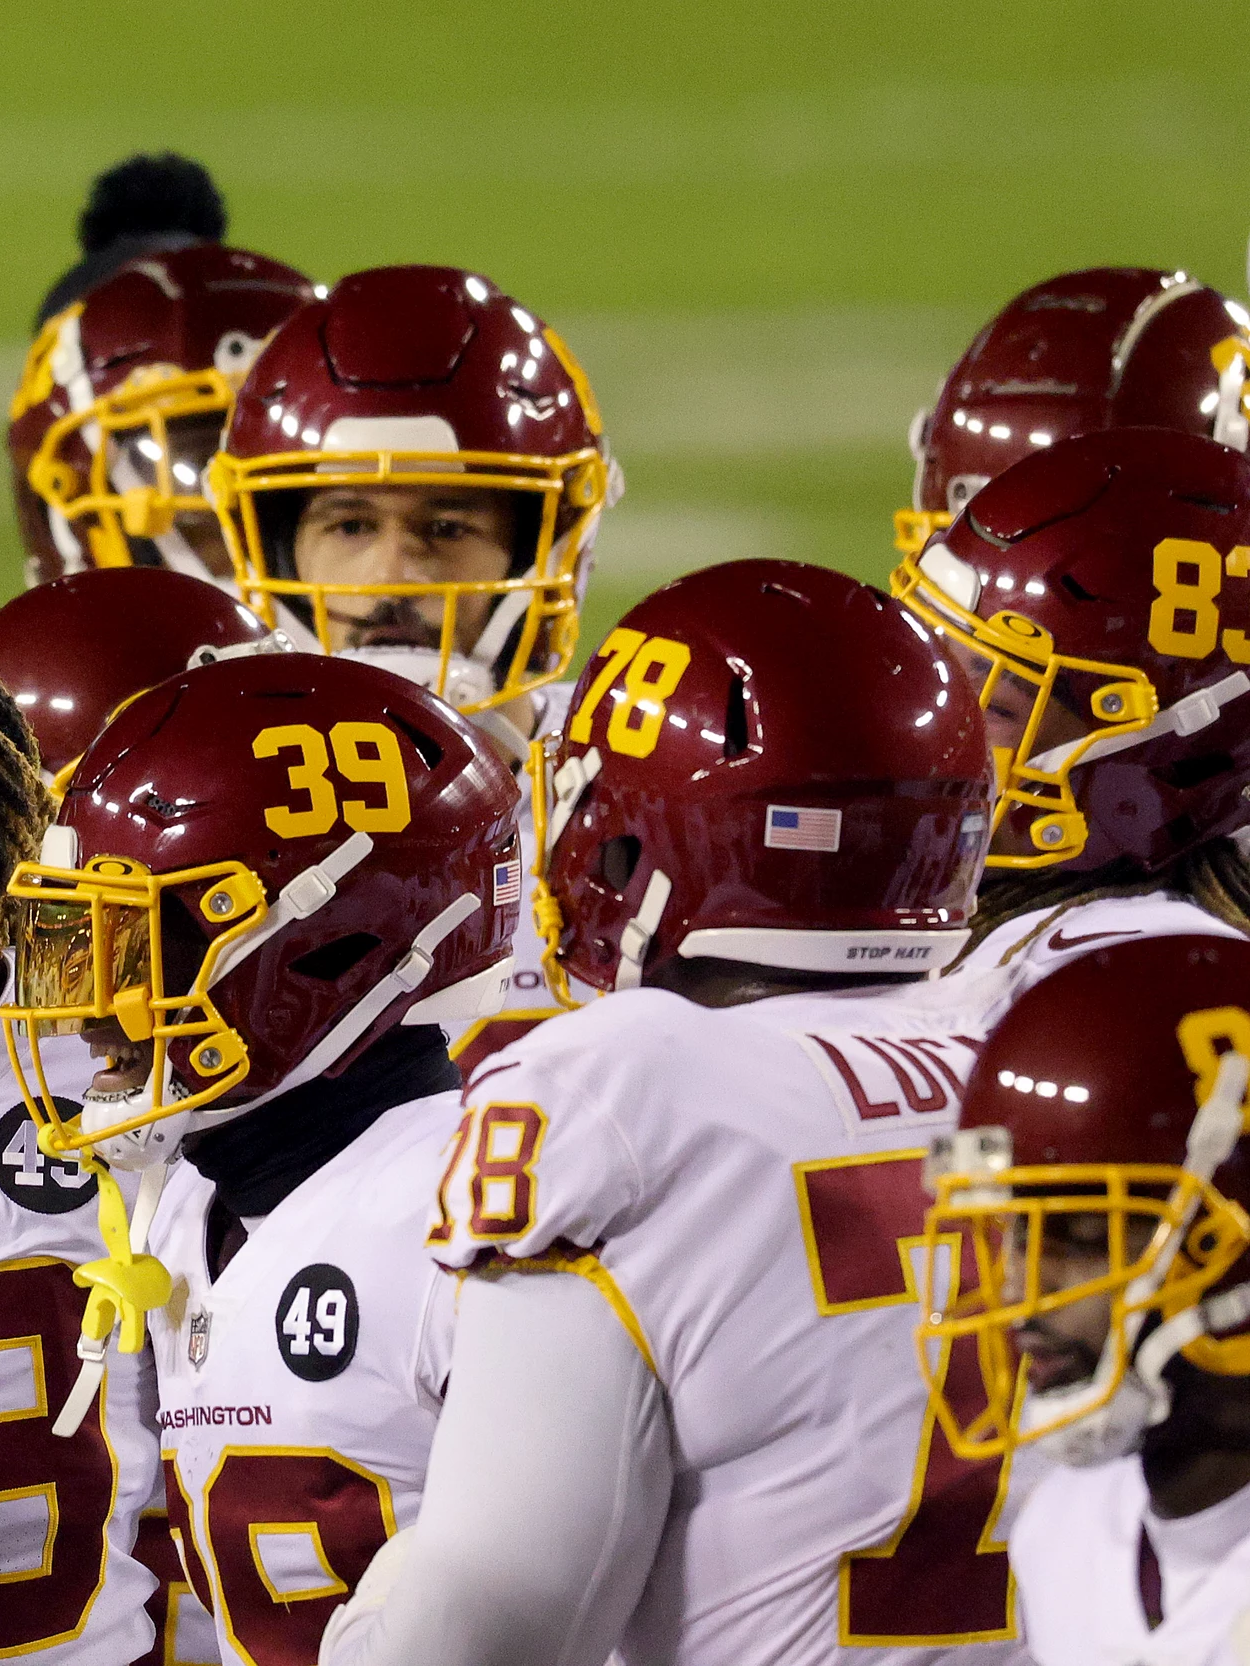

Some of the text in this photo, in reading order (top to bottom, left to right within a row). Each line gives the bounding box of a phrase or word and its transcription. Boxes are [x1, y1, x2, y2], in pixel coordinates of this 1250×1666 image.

[570, 628, 690, 758] 78
[252, 722, 411, 839] 39
[846, 947, 891, 959] STOP
[805, 1033, 987, 1120] LUC
[283, 1287, 348, 1356] 49
